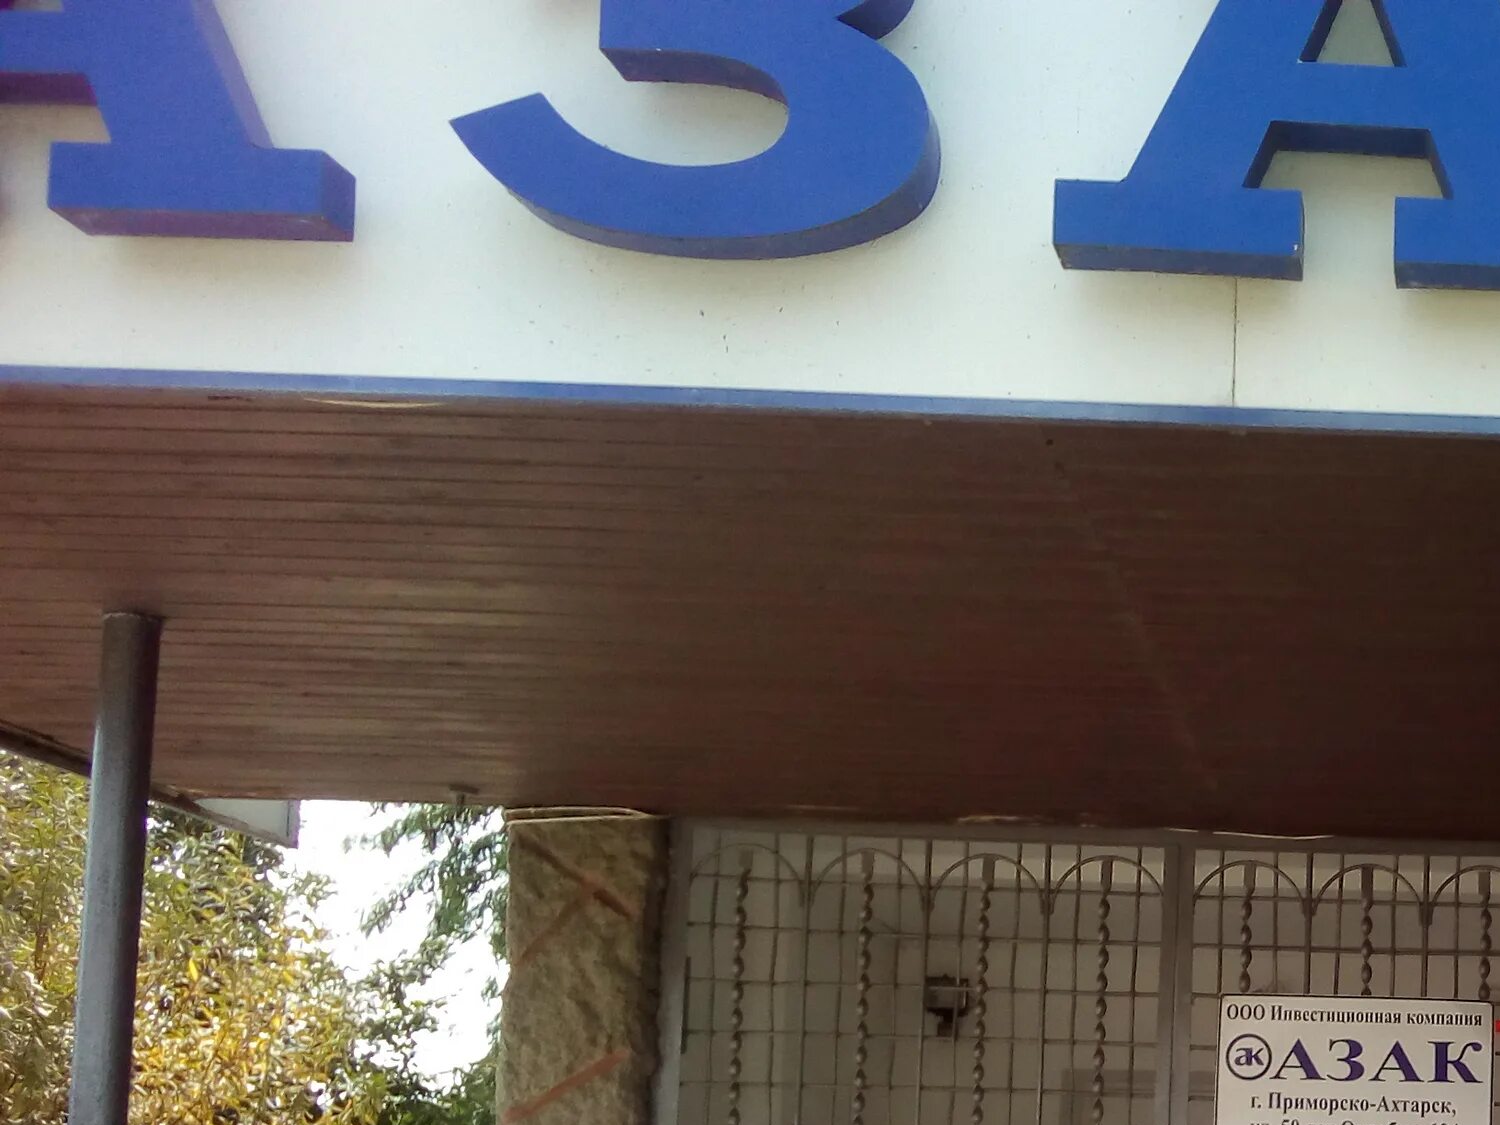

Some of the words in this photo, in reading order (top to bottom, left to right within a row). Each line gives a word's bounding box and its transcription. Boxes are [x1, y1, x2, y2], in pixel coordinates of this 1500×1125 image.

[1226, 1003, 1266, 1021] ООО
[1270, 1004, 1402, 1025] Инвестиционная
[1406, 1012, 1483, 1027] компания
[1269, 1038, 1484, 1084] АЗАК
[1250, 1096, 1262, 1110] г.
[1267, 1092, 1457, 1117] Приморско-Ахтарск,
